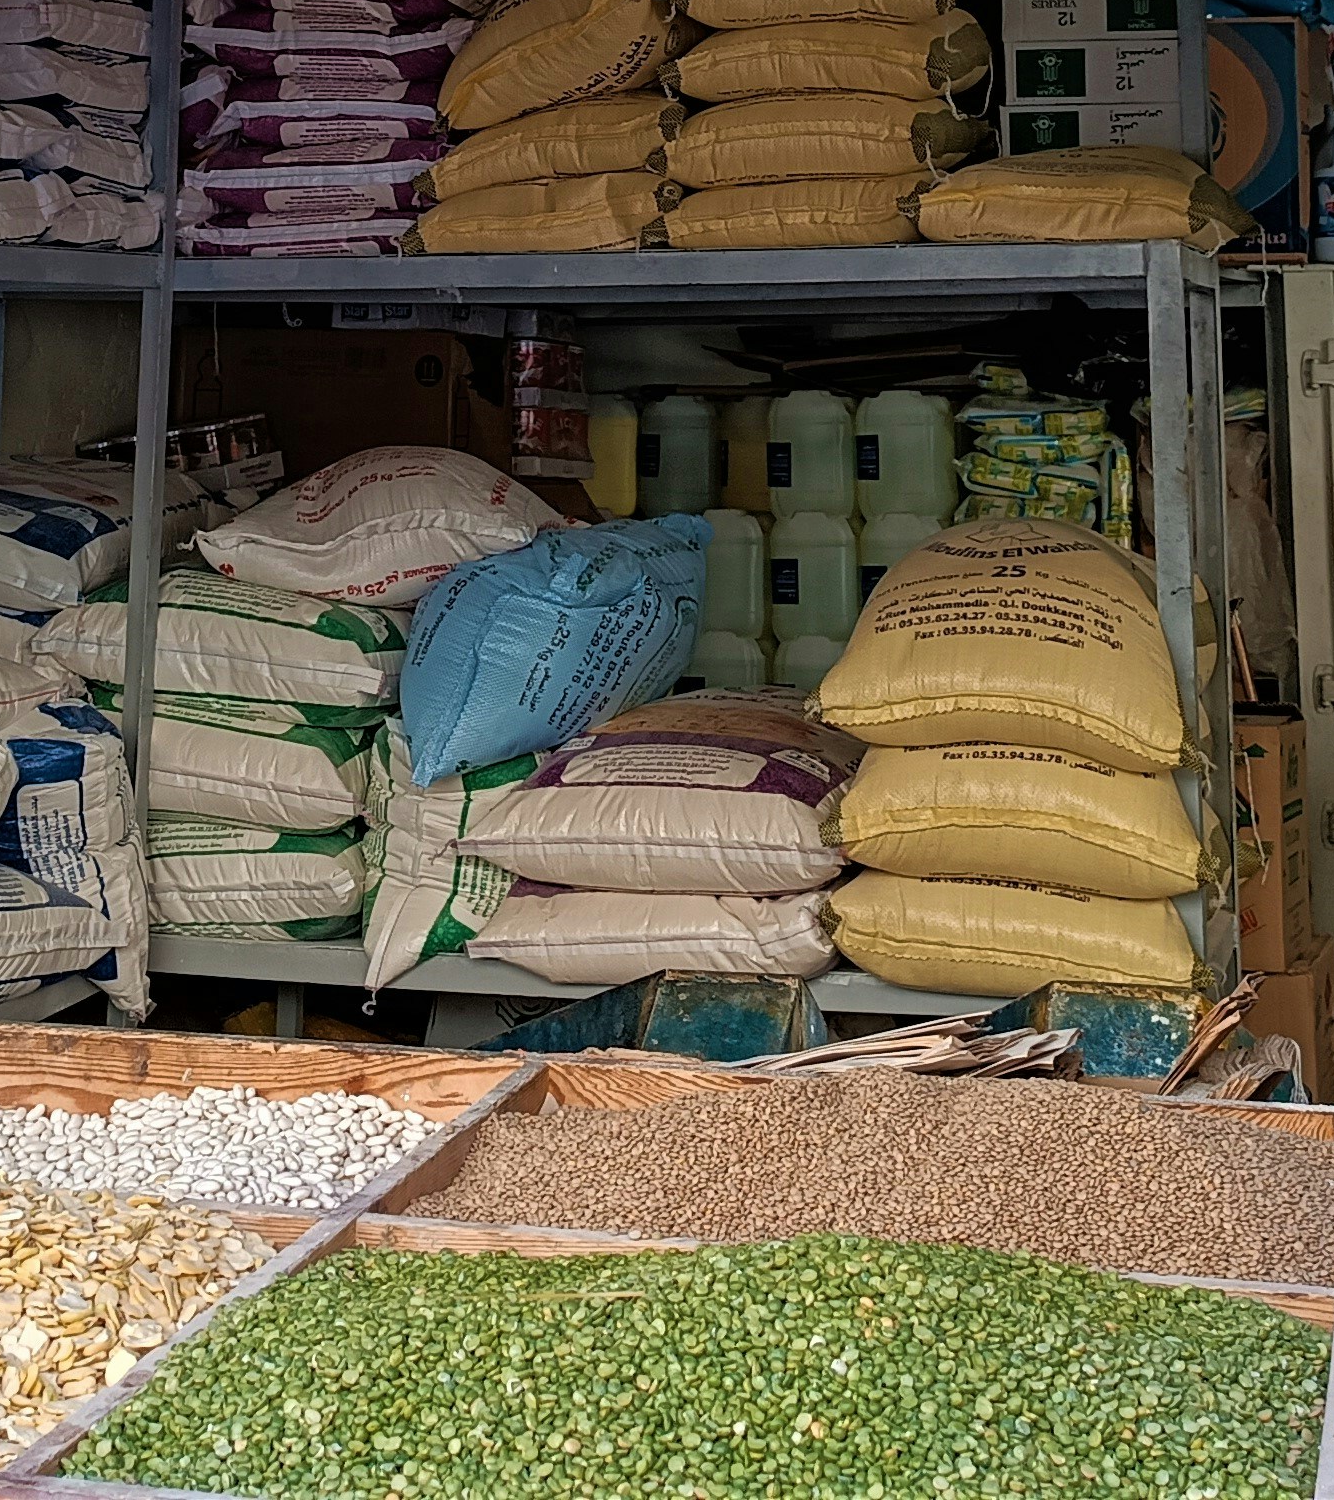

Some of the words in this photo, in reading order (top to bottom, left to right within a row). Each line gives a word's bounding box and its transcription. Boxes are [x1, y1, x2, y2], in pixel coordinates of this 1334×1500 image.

[1031, 0, 1077, 9] VERRES
[1058, 12, 1077, 26] 12
[615, 35, 659, 84] COMPLETE
[1116, 77, 1134, 91] 12
[385, 303, 409, 316] Star
[360, 473, 378, 487] 25
[380, 473, 393, 482] Kg
[1003, 548, 1023, 558] El
[1025, 541, 1100, 556] Wahda
[991, 565, 1027, 578] 25
[1035, 571, 1049, 580] Kg
[347, 584, 363, 597] Kg
[366, 583, 387, 597] 25
[448, 578, 468, 597] 25
[640, 600, 652, 618] 22
[909, 599, 990, 614] Mohammedia
[1094, 617, 1115, 634] FES
[898, 611, 986, 629] 05.35.62.24.27
[550, 628, 571, 650] 25
[614, 619, 643, 659] Route
[914, 631, 935, 641] Fax
[572, 605, 619, 684] 5.23.29.77.16
[537, 647, 555, 662] Kg
[599, 660, 618, 688] Ben
[558, 690, 601, 739] Slimane
[942, 751, 964, 761] Fax
